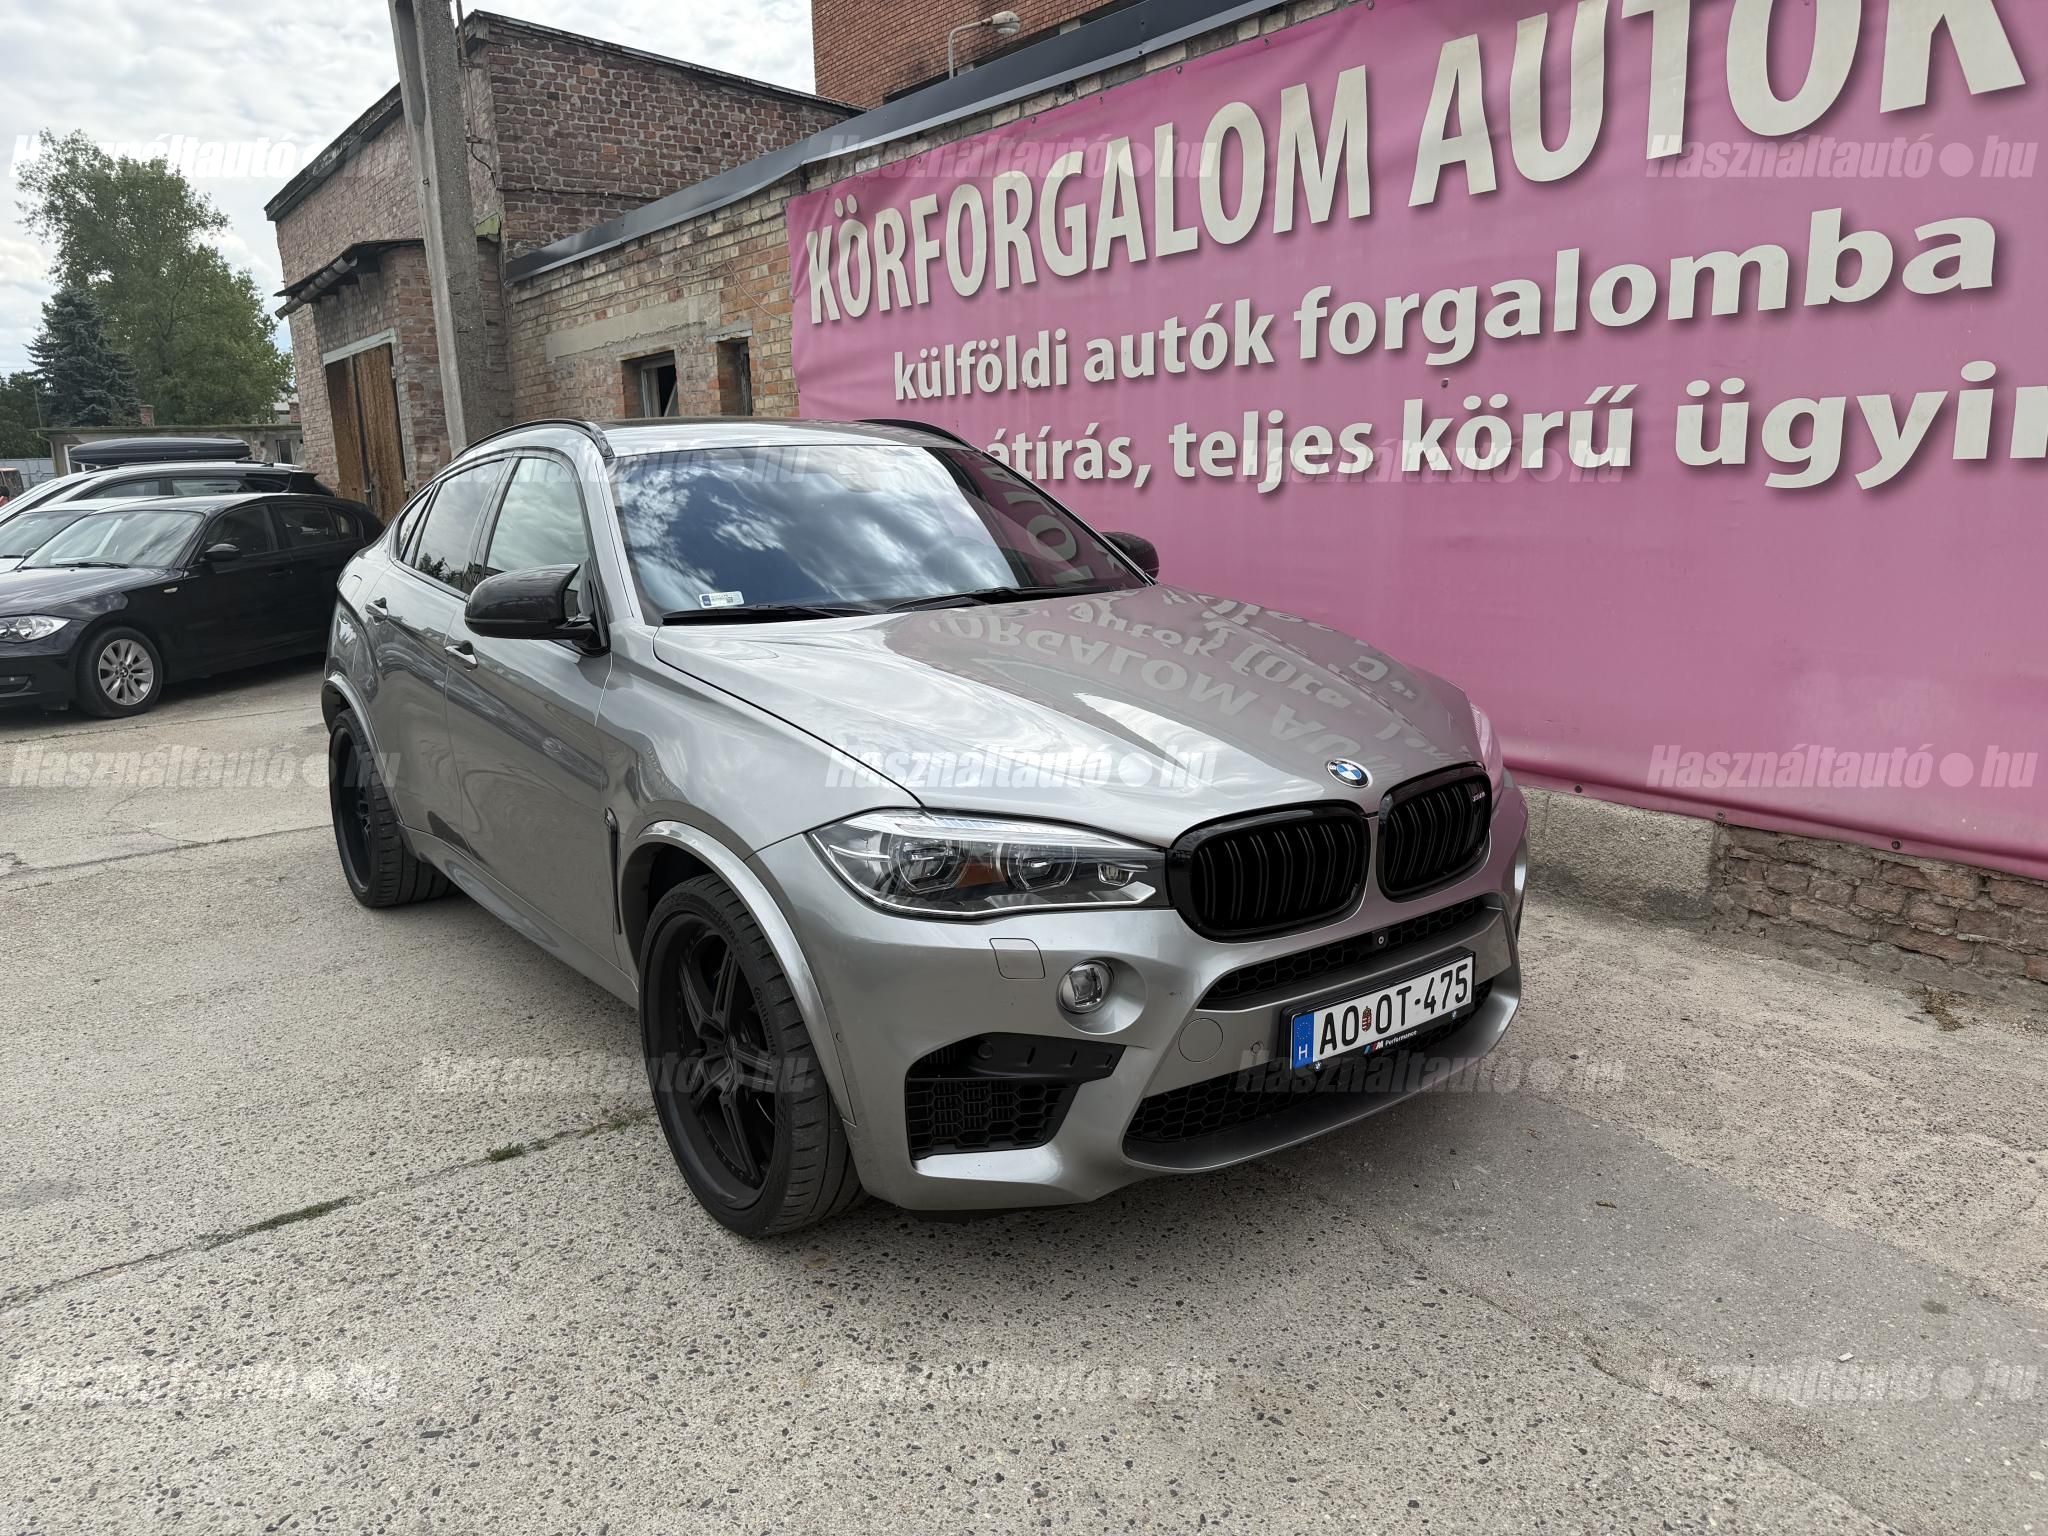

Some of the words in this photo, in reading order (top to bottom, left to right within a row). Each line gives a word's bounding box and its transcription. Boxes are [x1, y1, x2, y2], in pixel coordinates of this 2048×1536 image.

[807, 65, 1371, 323] KÖRFORGALOM
[894, 328, 1067, 401] külföldi
[1084, 298, 1275, 383] autók
[1293, 207, 1997, 366] forgalomba
[987, 422, 1152, 489] átírás,
[1169, 409, 1374, 494] teljes
[1401, 384, 1639, 472] körű
[1298, 1043, 1308, 1060] H
